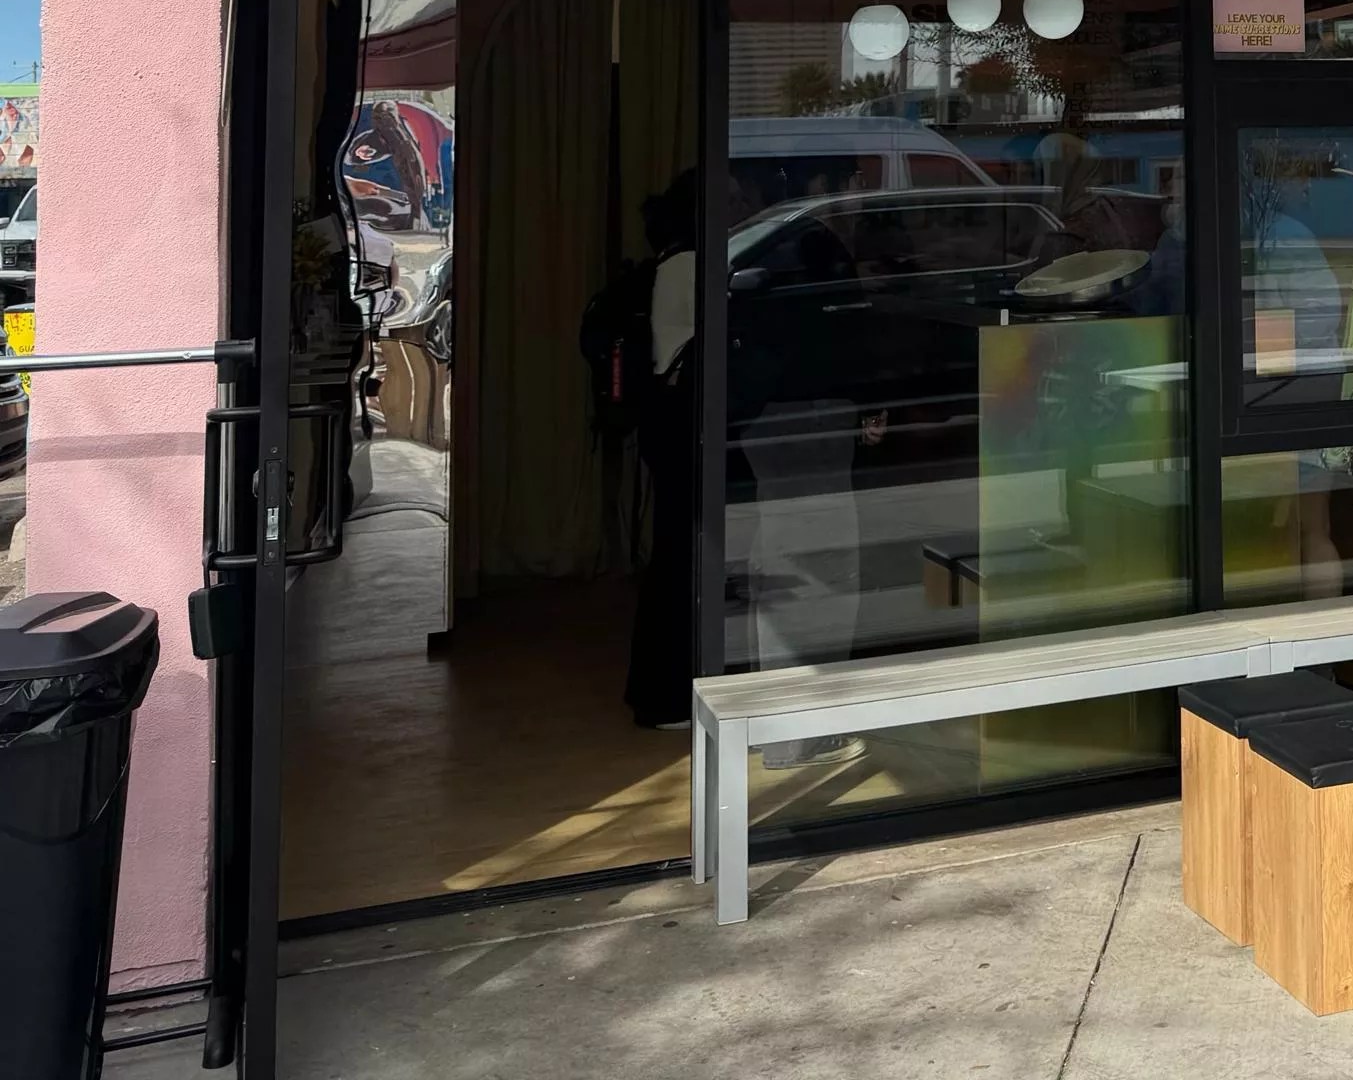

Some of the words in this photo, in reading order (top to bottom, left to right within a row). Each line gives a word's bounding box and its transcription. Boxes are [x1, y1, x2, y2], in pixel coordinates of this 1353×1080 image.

[1228, 13, 1258, 24] LEAVE
[1259, 14, 1286, 24] YOUR
[1241, 35, 1273, 46] HERE!
